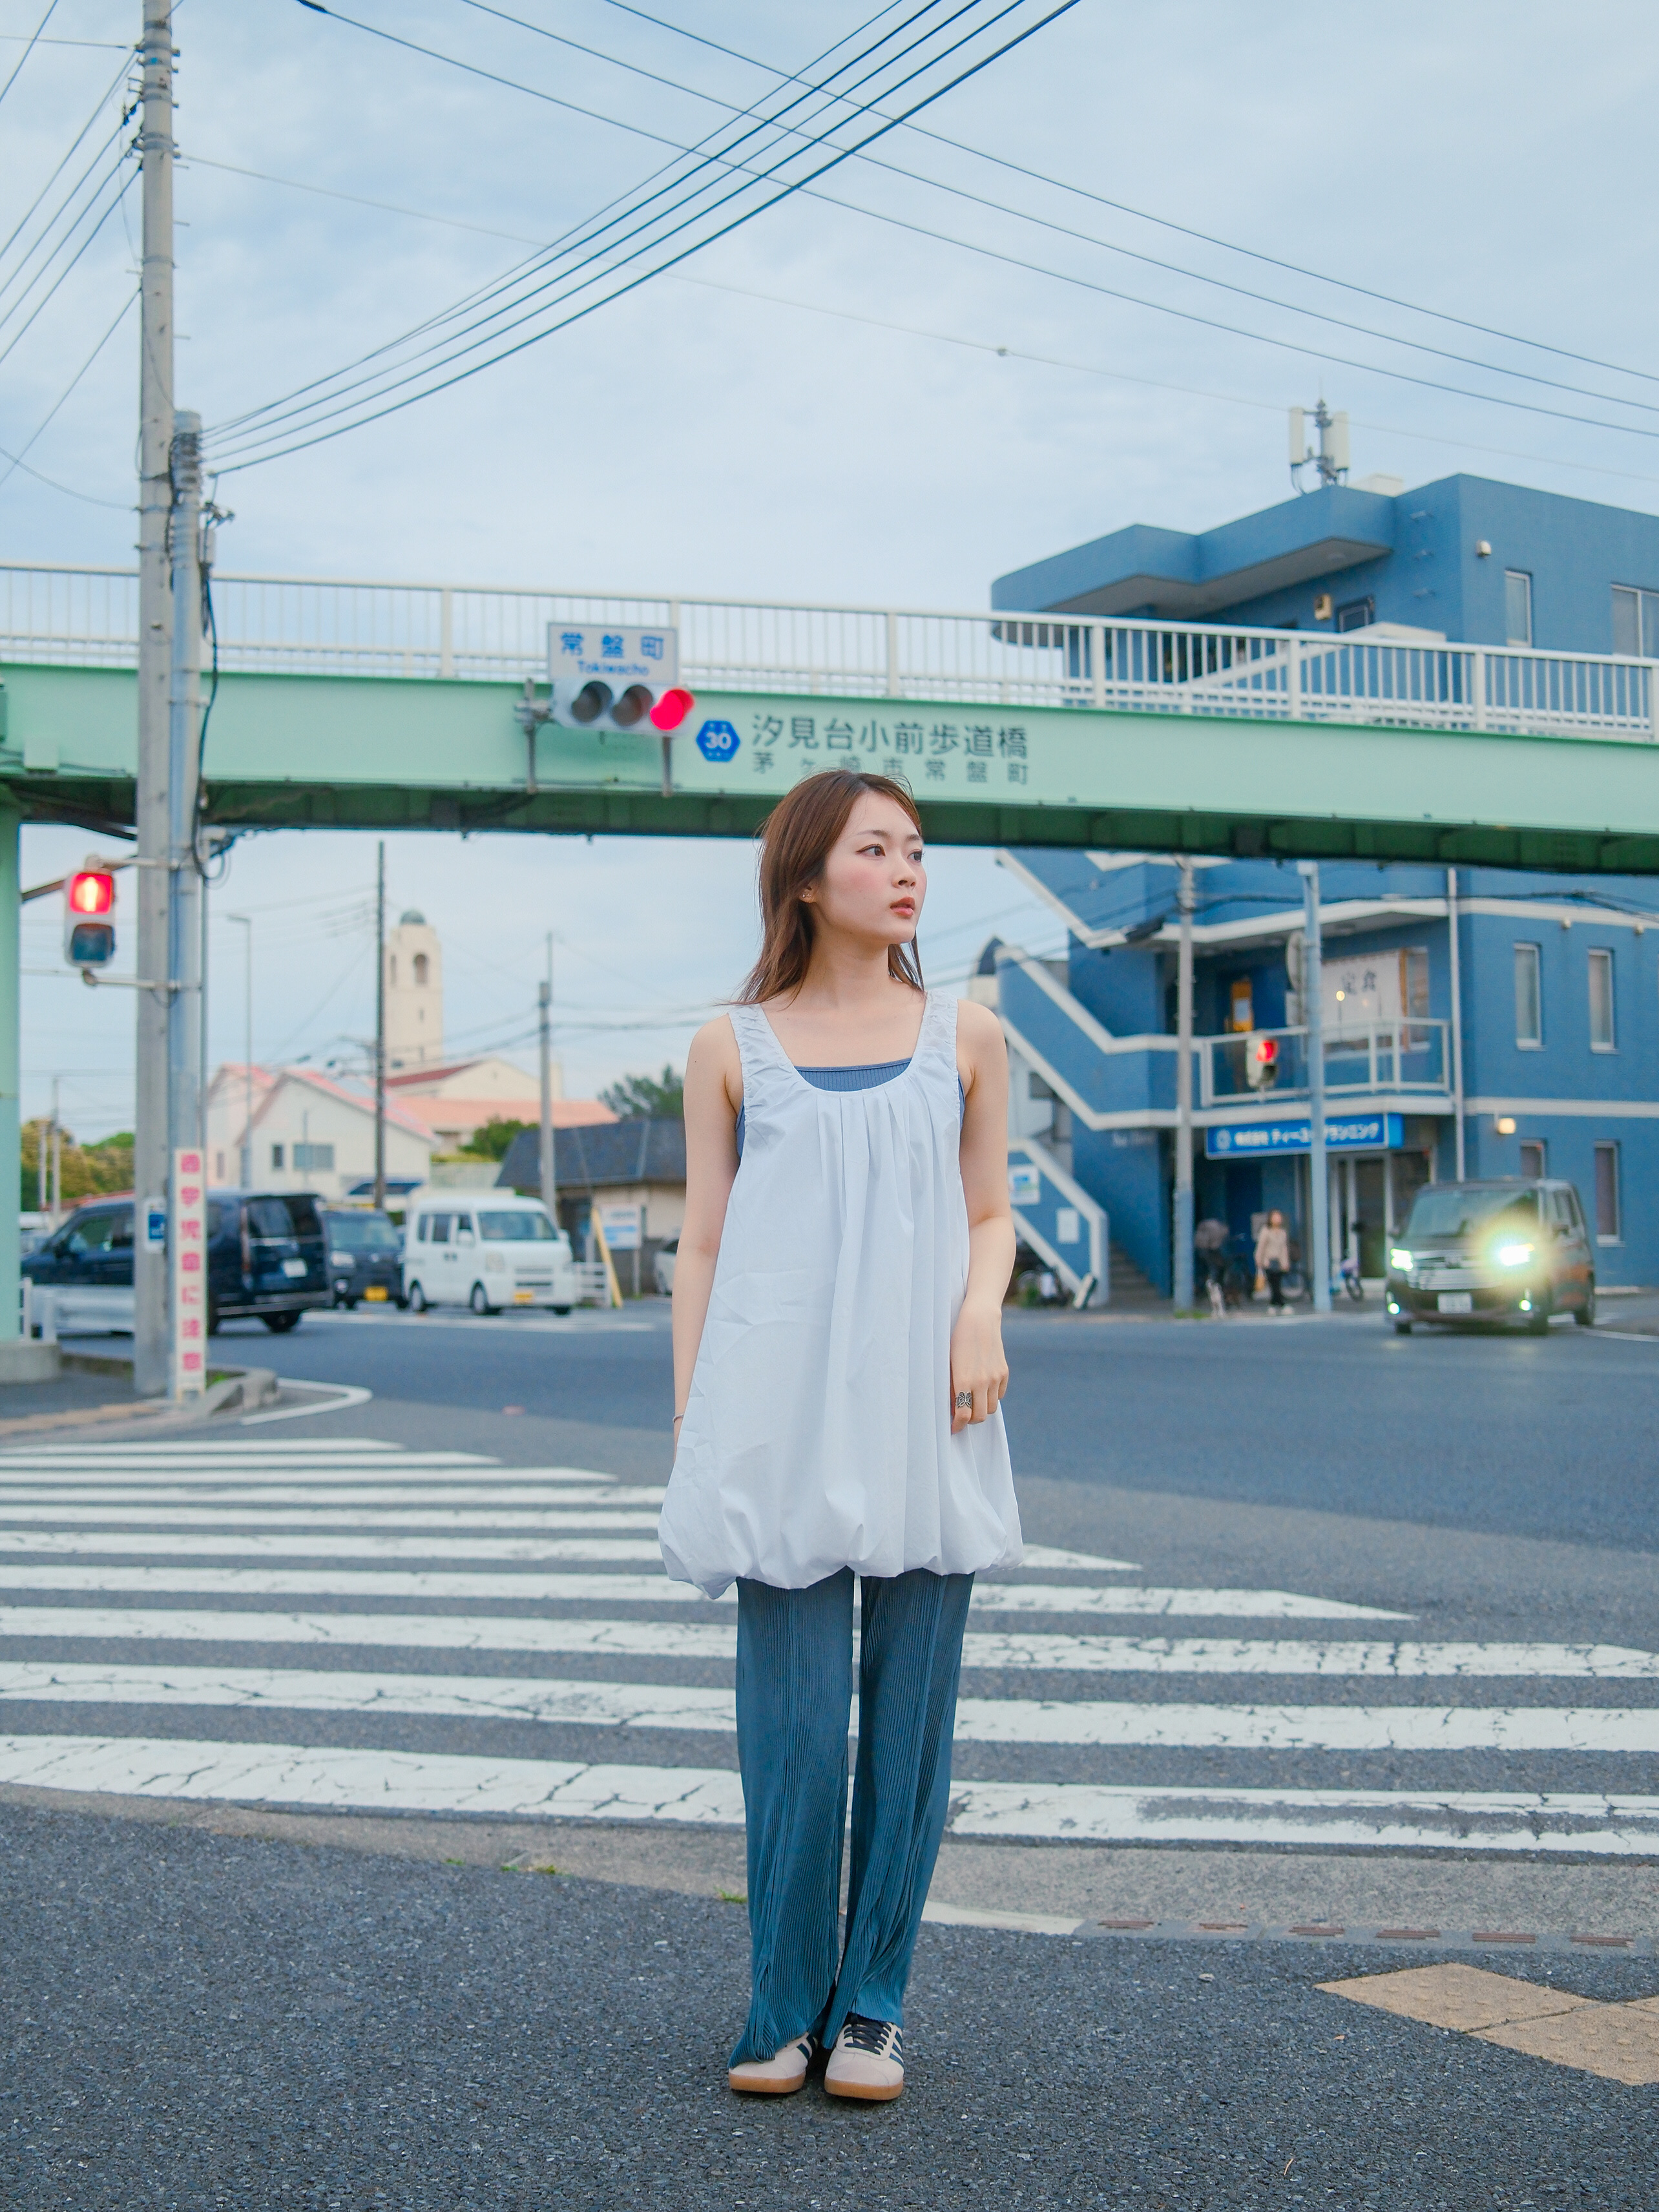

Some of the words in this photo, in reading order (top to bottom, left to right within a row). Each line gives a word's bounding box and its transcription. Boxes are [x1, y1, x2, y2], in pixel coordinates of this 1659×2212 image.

[561, 632, 664, 660] 常盤町
[705, 731, 733, 750] 30
[752, 714, 1028, 759] 汐見台小前歩道橋
